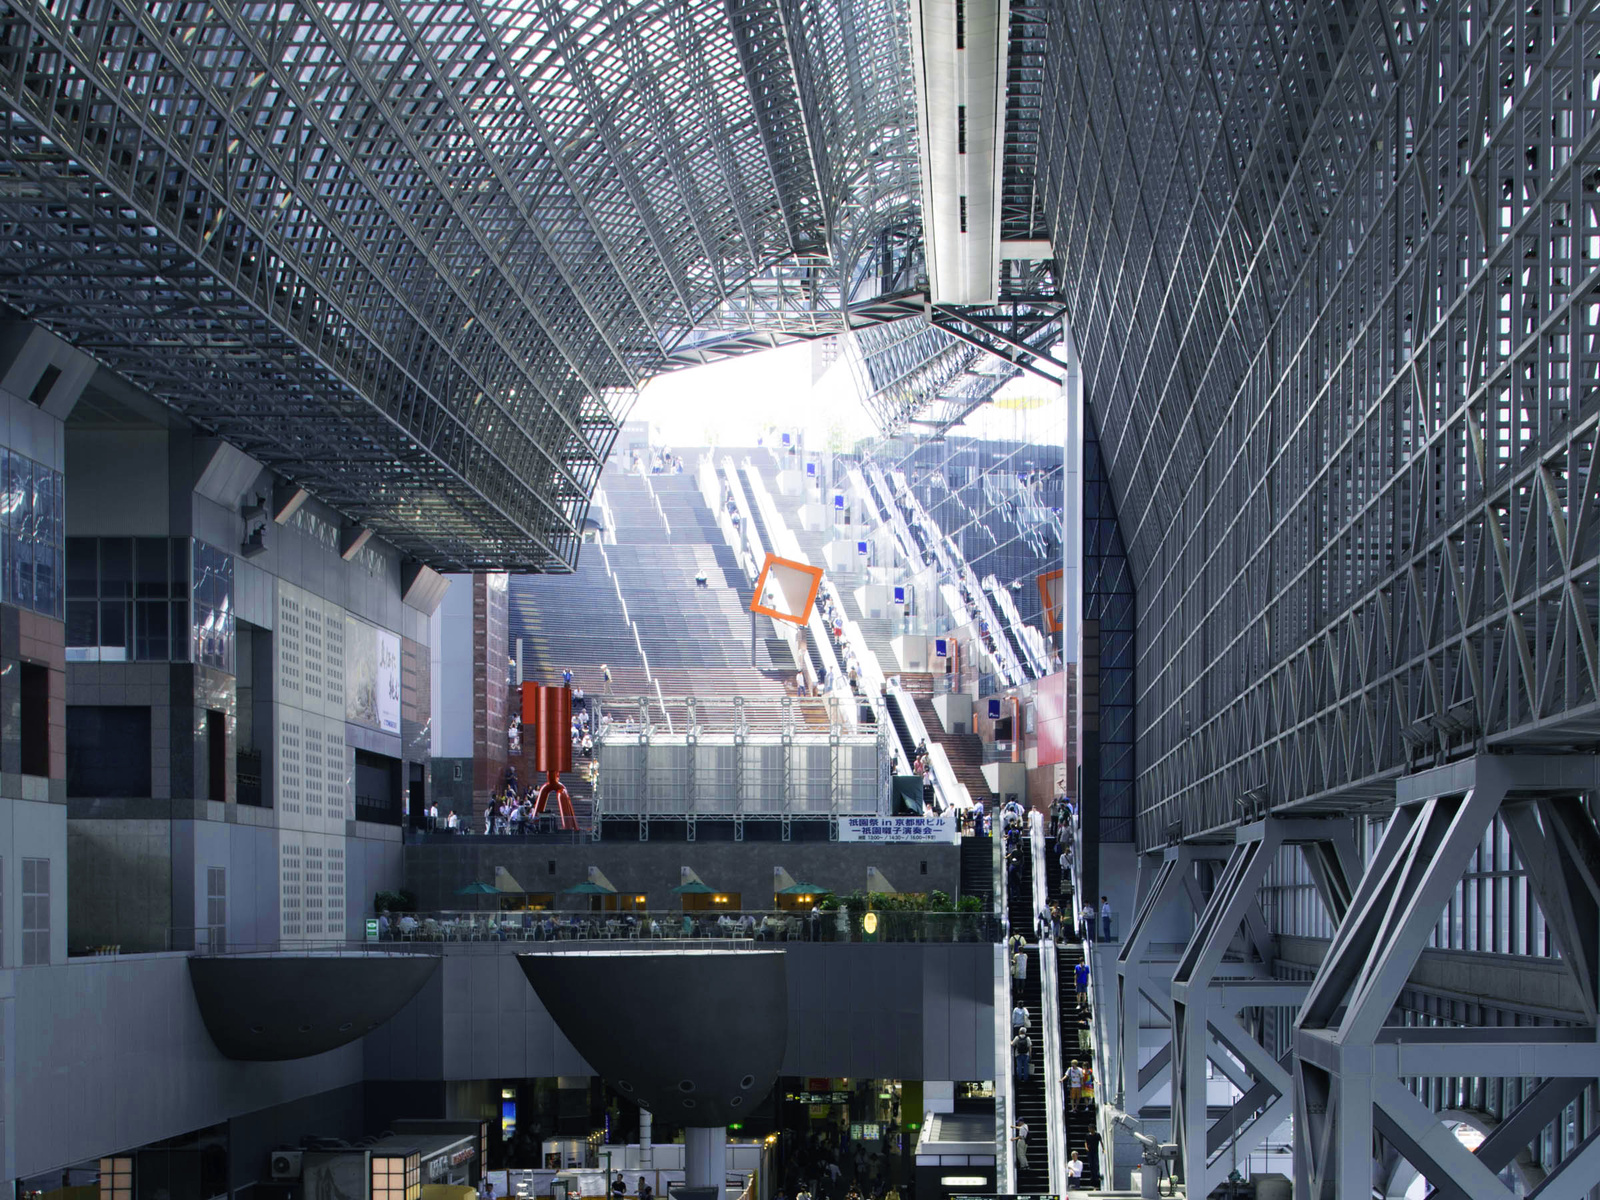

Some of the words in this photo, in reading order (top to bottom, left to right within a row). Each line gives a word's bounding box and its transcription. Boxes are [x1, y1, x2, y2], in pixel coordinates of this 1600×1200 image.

[896, 818, 945, 827] 京都駅ビル
